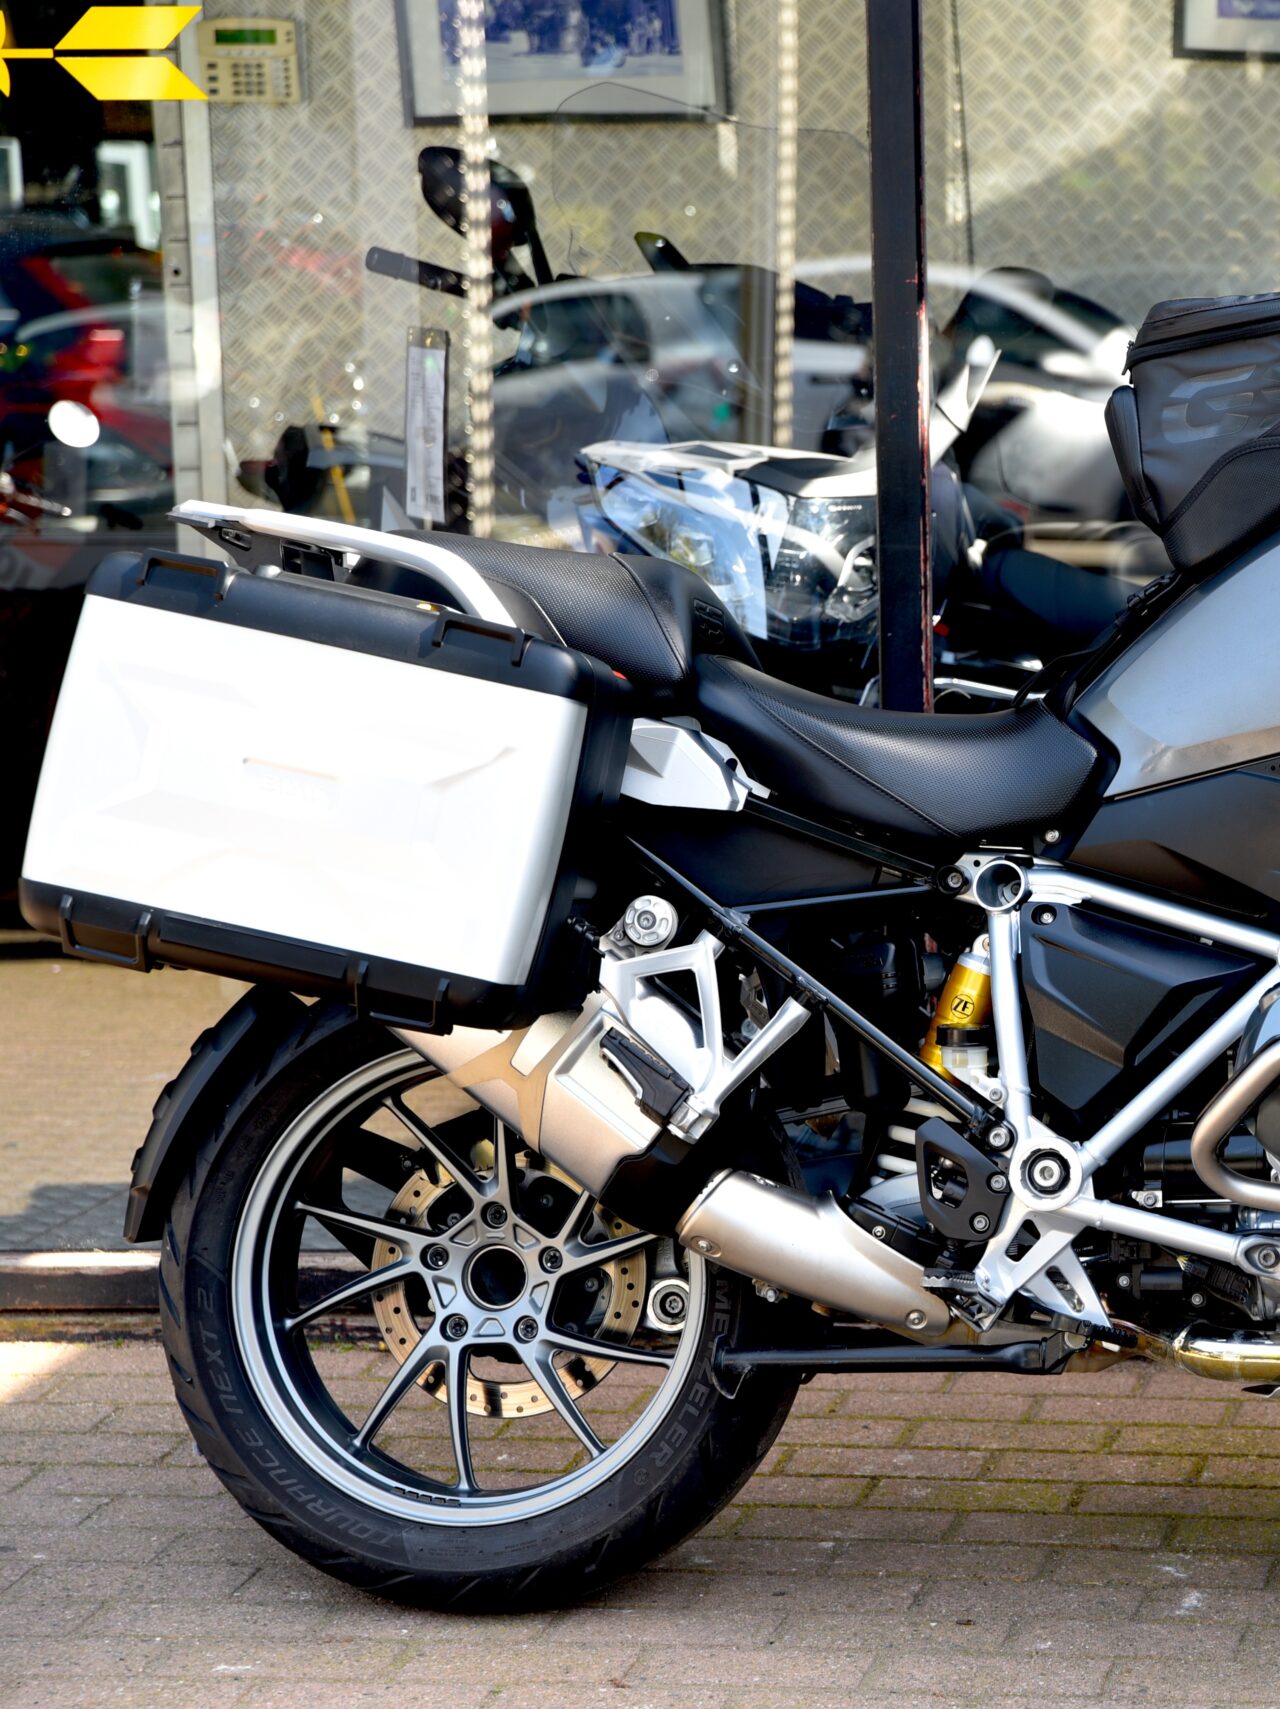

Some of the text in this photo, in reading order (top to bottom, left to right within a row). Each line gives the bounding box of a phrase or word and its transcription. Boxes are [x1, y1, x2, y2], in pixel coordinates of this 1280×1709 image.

[952, 997, 973, 1014] ZF
[196, 1287, 394, 1551] TOURANCE NEXT 2
